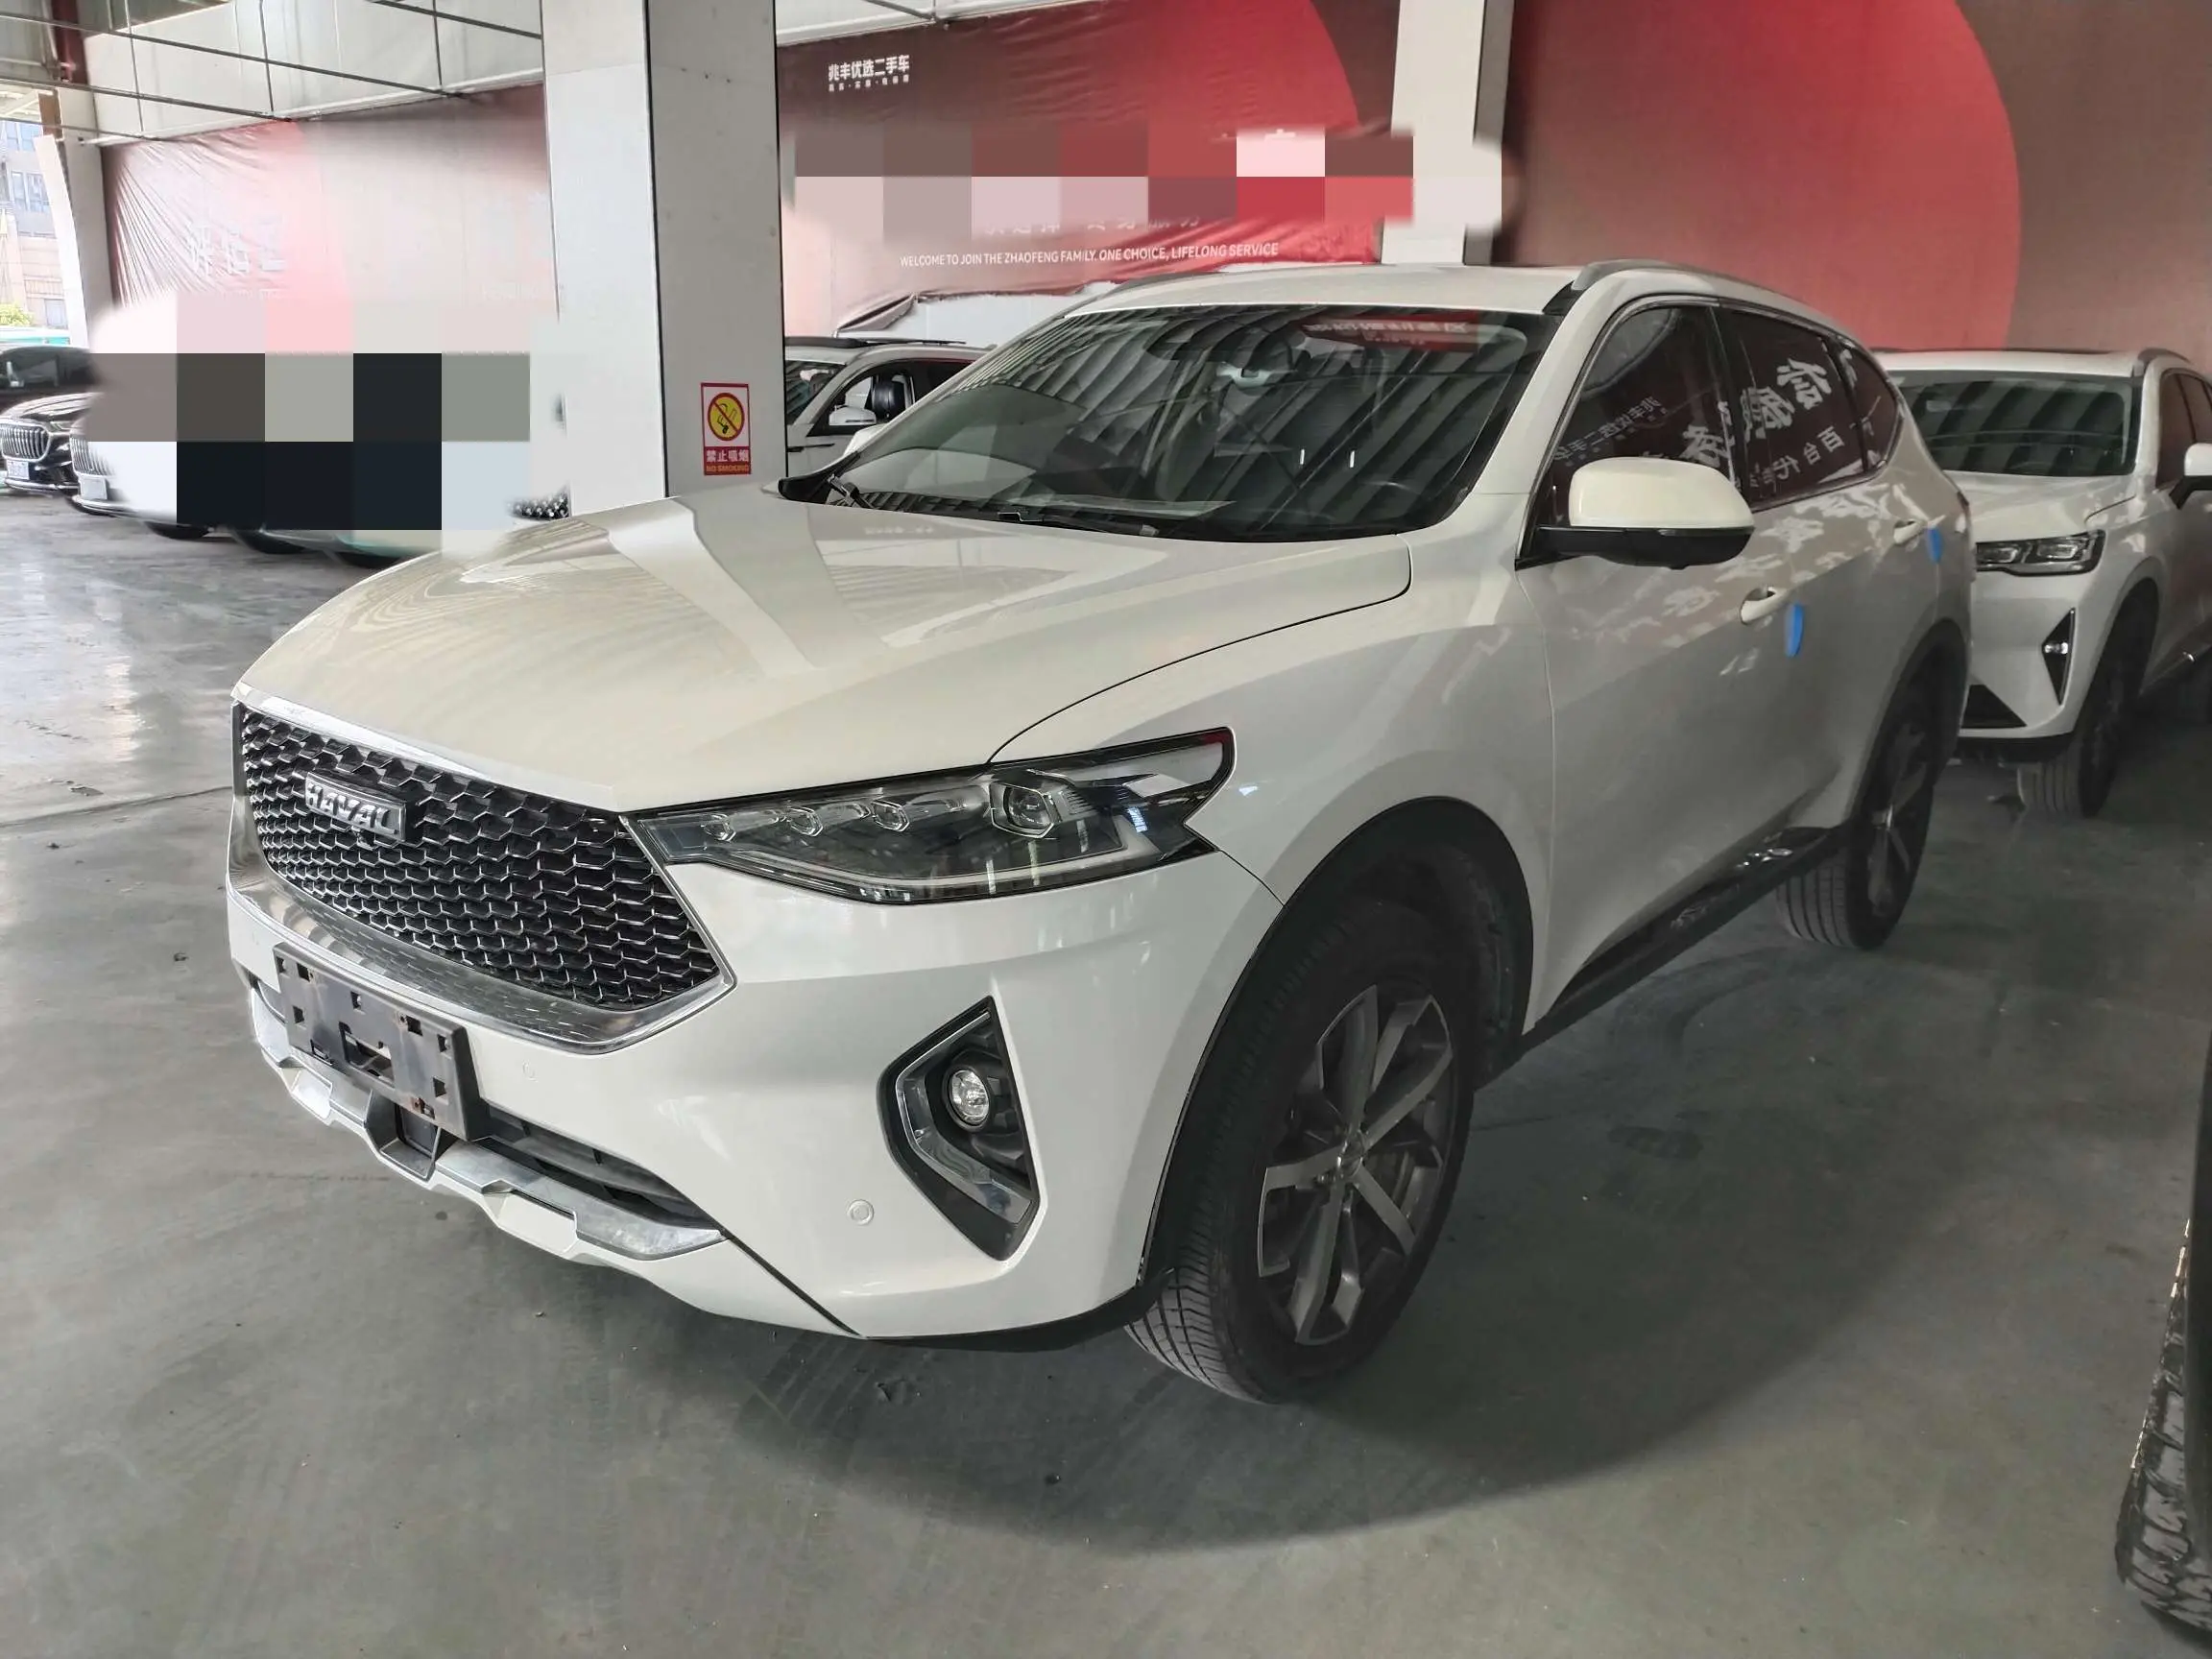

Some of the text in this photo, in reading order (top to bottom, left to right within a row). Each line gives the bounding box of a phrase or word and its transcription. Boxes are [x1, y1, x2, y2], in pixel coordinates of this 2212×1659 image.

[829, 55, 909, 81] 兆丰优选二手车
[901, 253, 945, 267] WELCOME
[947, 253, 959, 266] TO
[961, 252, 982, 265] JOIN
[984, 252, 1002, 264] THE
[1004, 250, 1059, 264] ZHAOFENG
[1099, 247, 1121, 260] ONE
[1123, 246, 1169, 261] CHOICE,
[1171, 244, 1227, 259] LIFELONG
[1229, 242, 1278, 256] SERVICE
[706, 449, 749, 462] 禁止吸烟
[307, 781, 398, 834] HAVAL
